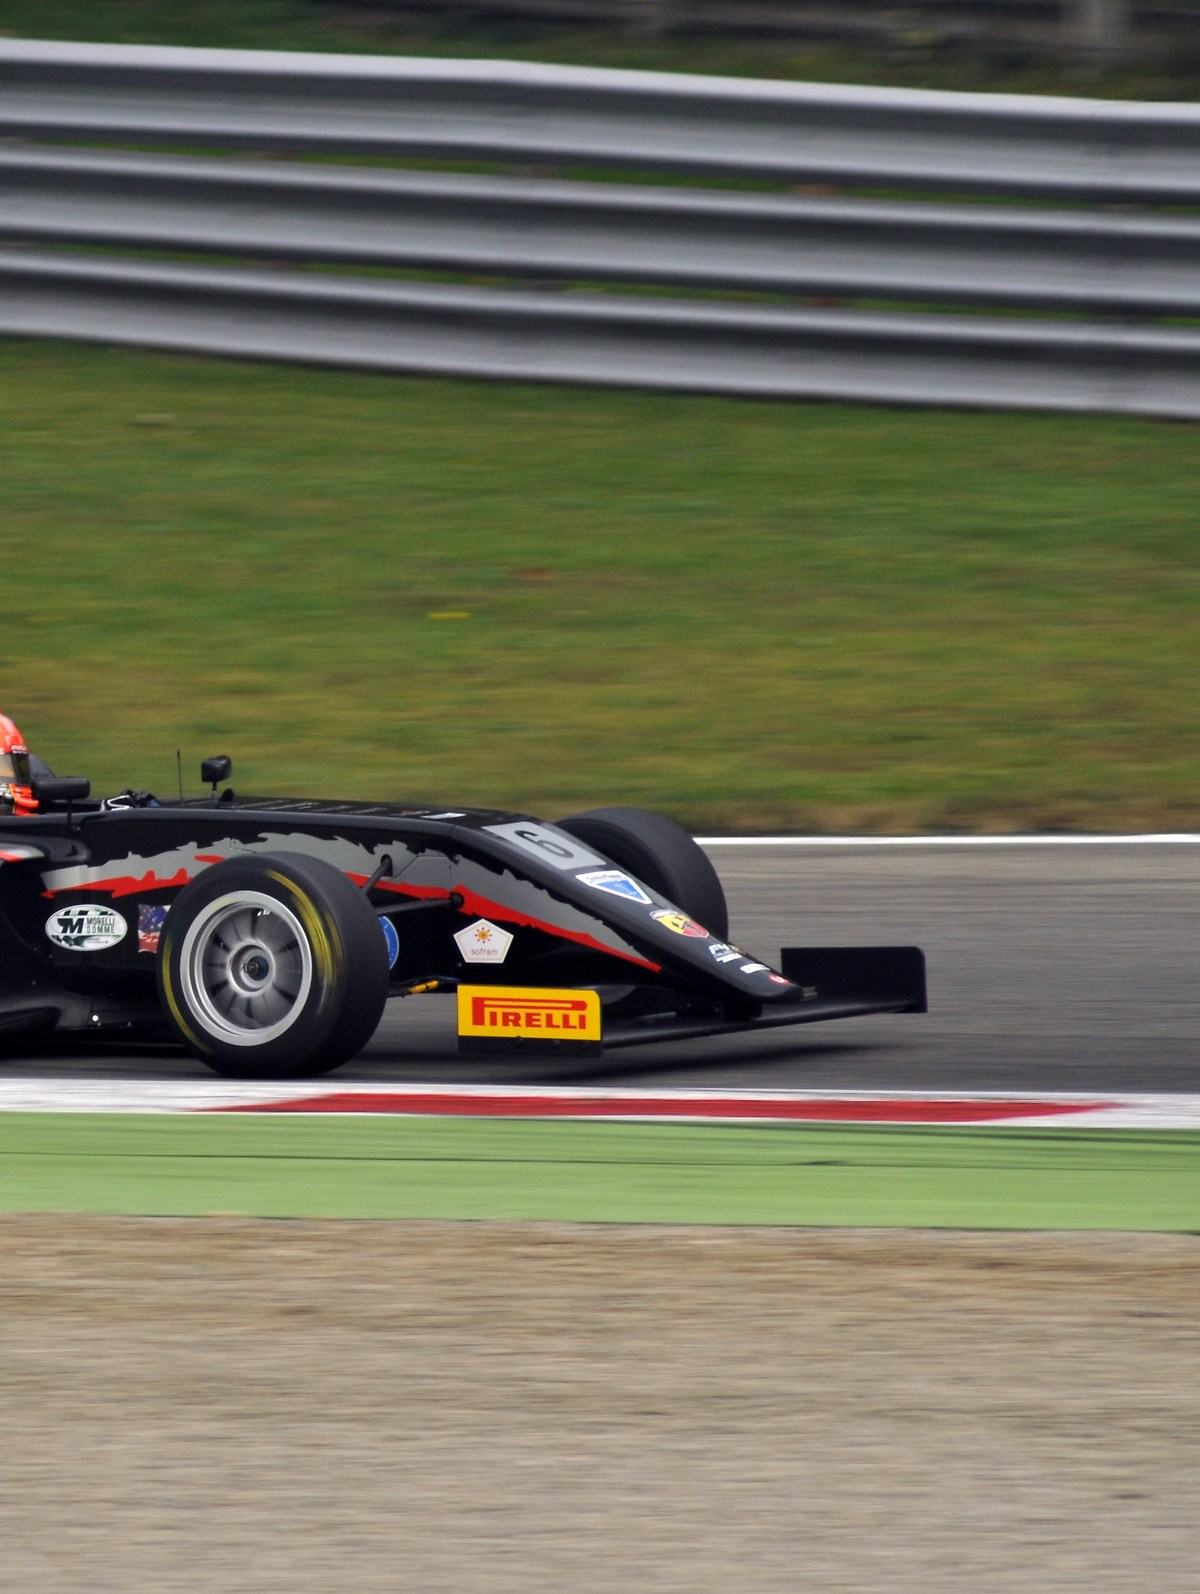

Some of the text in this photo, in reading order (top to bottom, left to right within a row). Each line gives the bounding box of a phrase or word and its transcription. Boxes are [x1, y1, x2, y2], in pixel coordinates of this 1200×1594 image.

[514, 830, 574, 858] 6
[86, 917, 115, 926] MORELLI
[86, 925, 115, 934] GOMME
[472, 997, 587, 1029] PIRELLI
